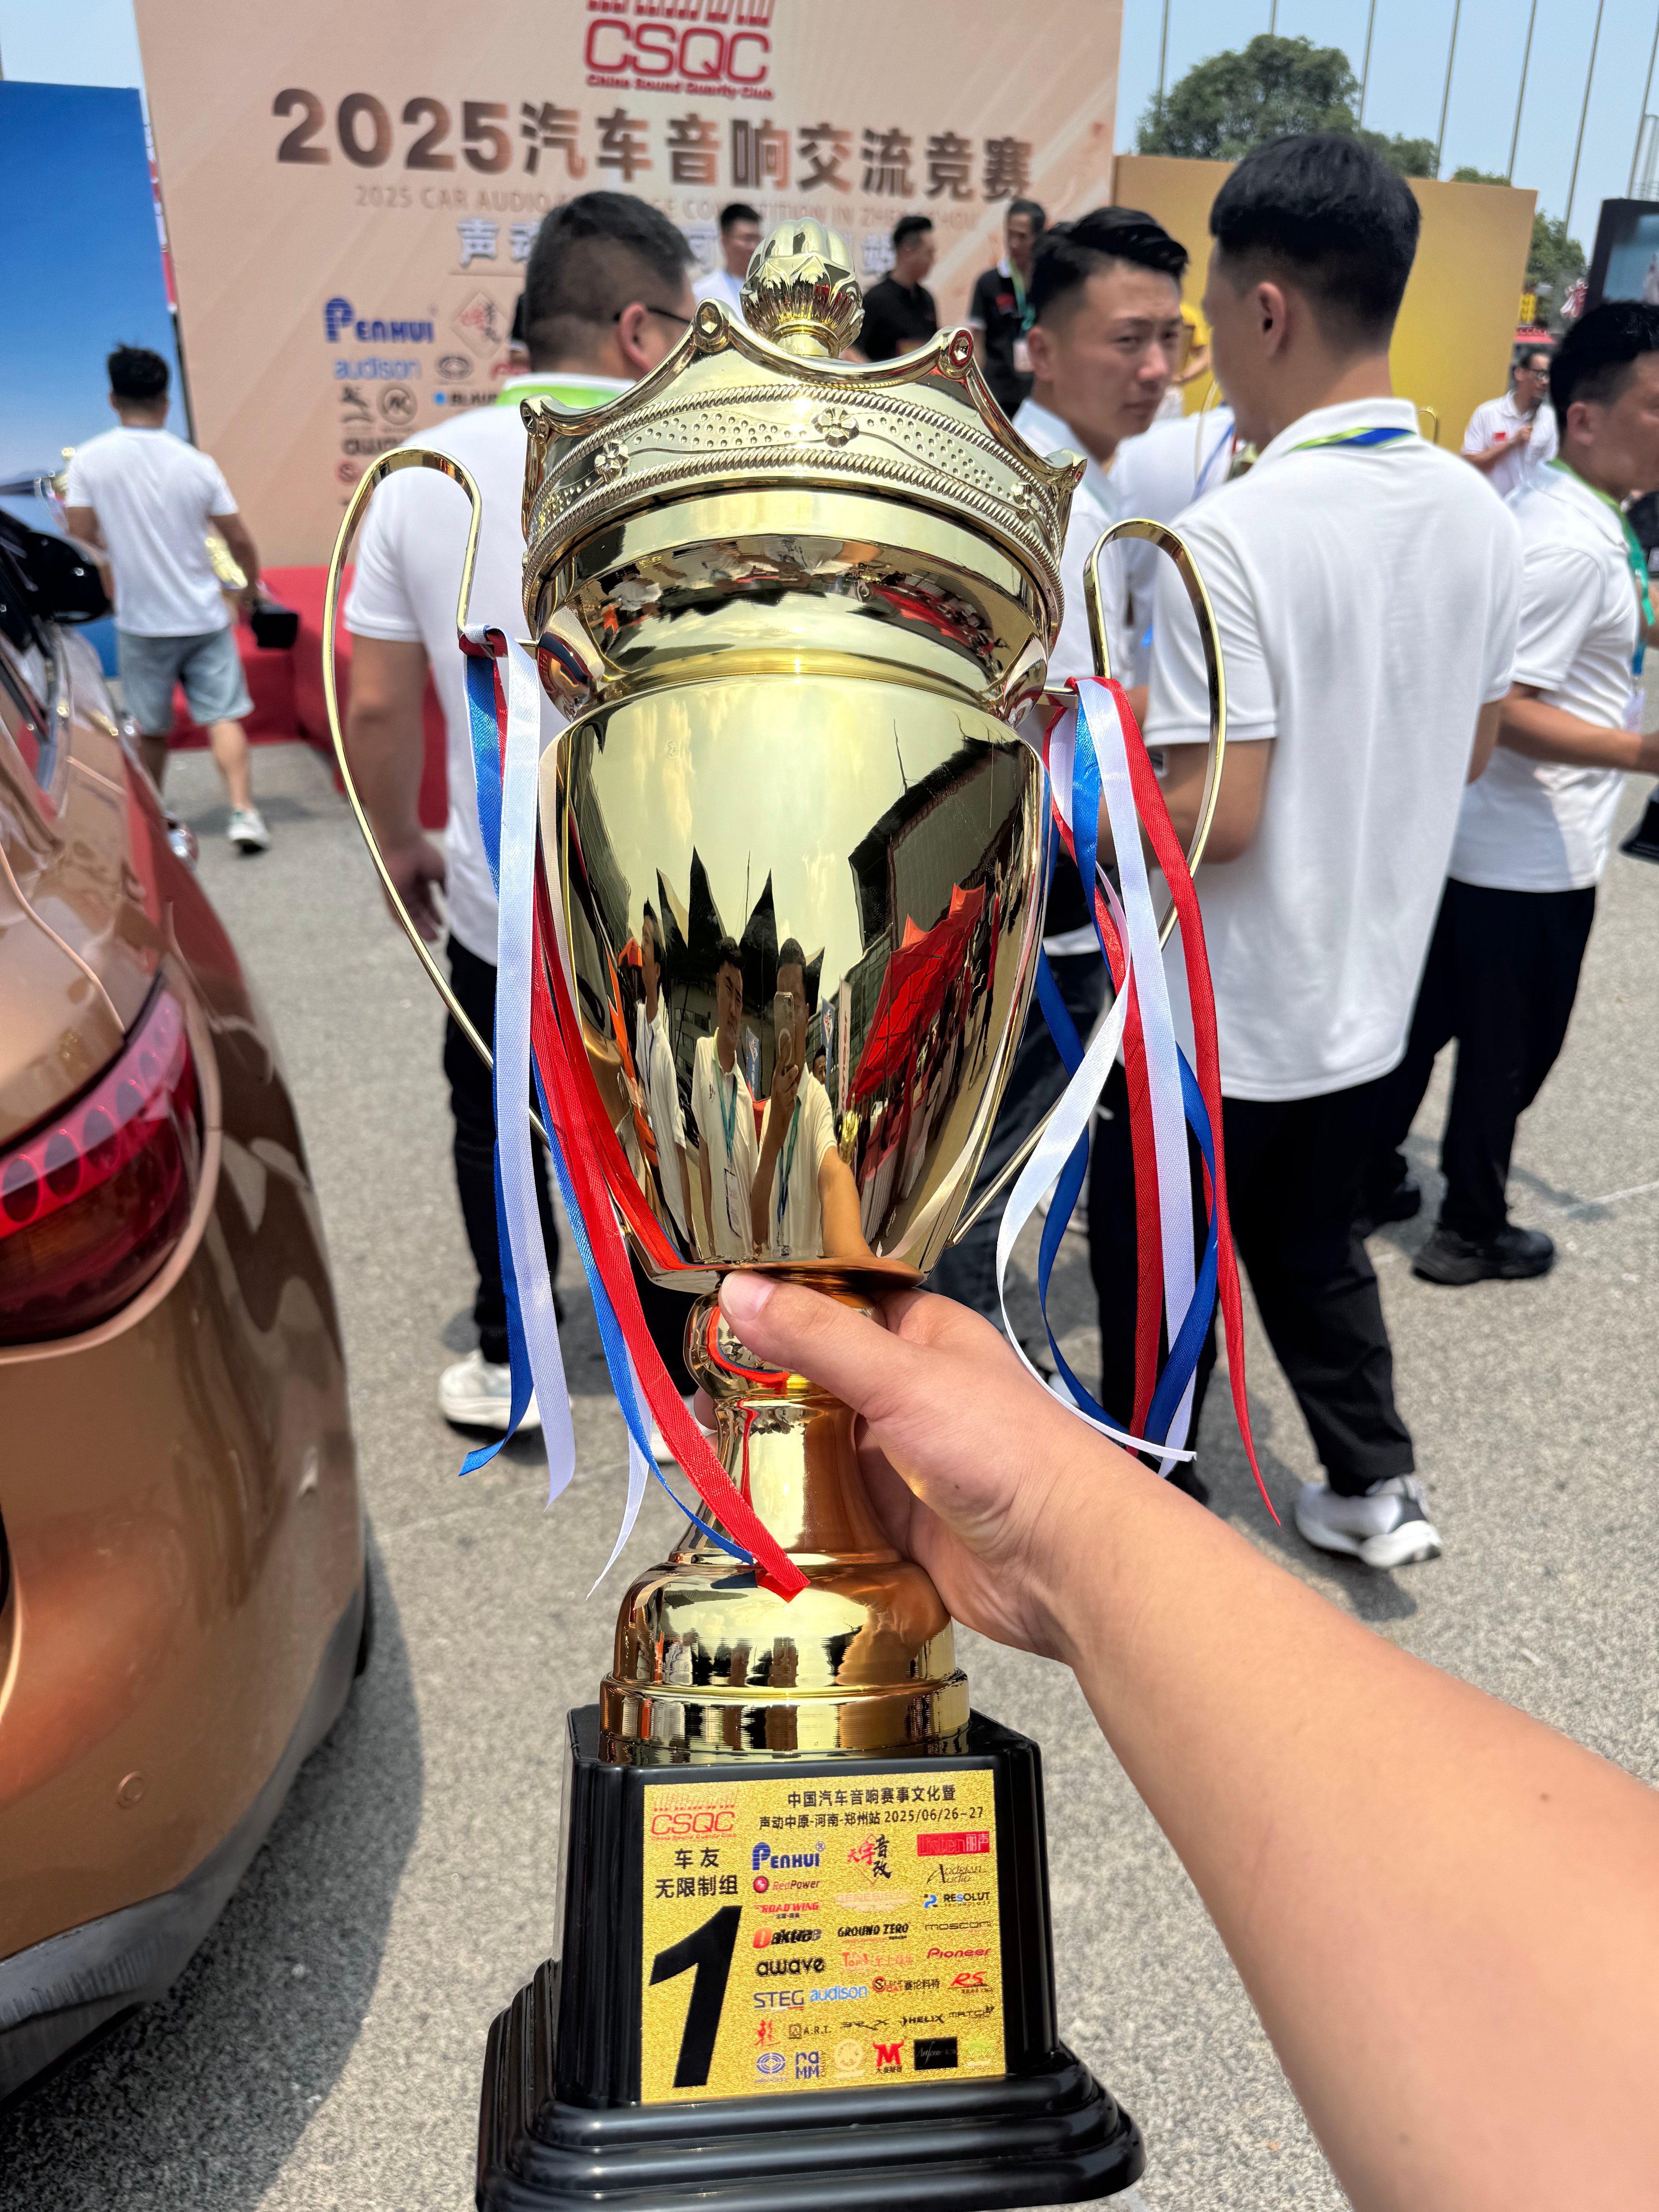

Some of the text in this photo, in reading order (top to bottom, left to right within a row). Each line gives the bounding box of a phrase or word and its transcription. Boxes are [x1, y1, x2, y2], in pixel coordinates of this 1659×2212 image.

[586, 18, 770, 84] CSQC
[272, 88, 1033, 202] 2025汽车音响交流竞赛
[788, 1784, 955, 1808] 中国汽车音响赛事文化暨
[651, 1811, 735, 1835] CSQC
[655, 1874, 738, 1899] 无限制组
[837, 1922, 909, 1937] GROUND ZERO
[926, 1947, 991, 1959] Pioneer
[756, 1956, 825, 1977] awave
[649, 1906, 742, 2088] 1
[754, 1989, 804, 2008] STEG
[809, 1985, 868, 2002] audison
